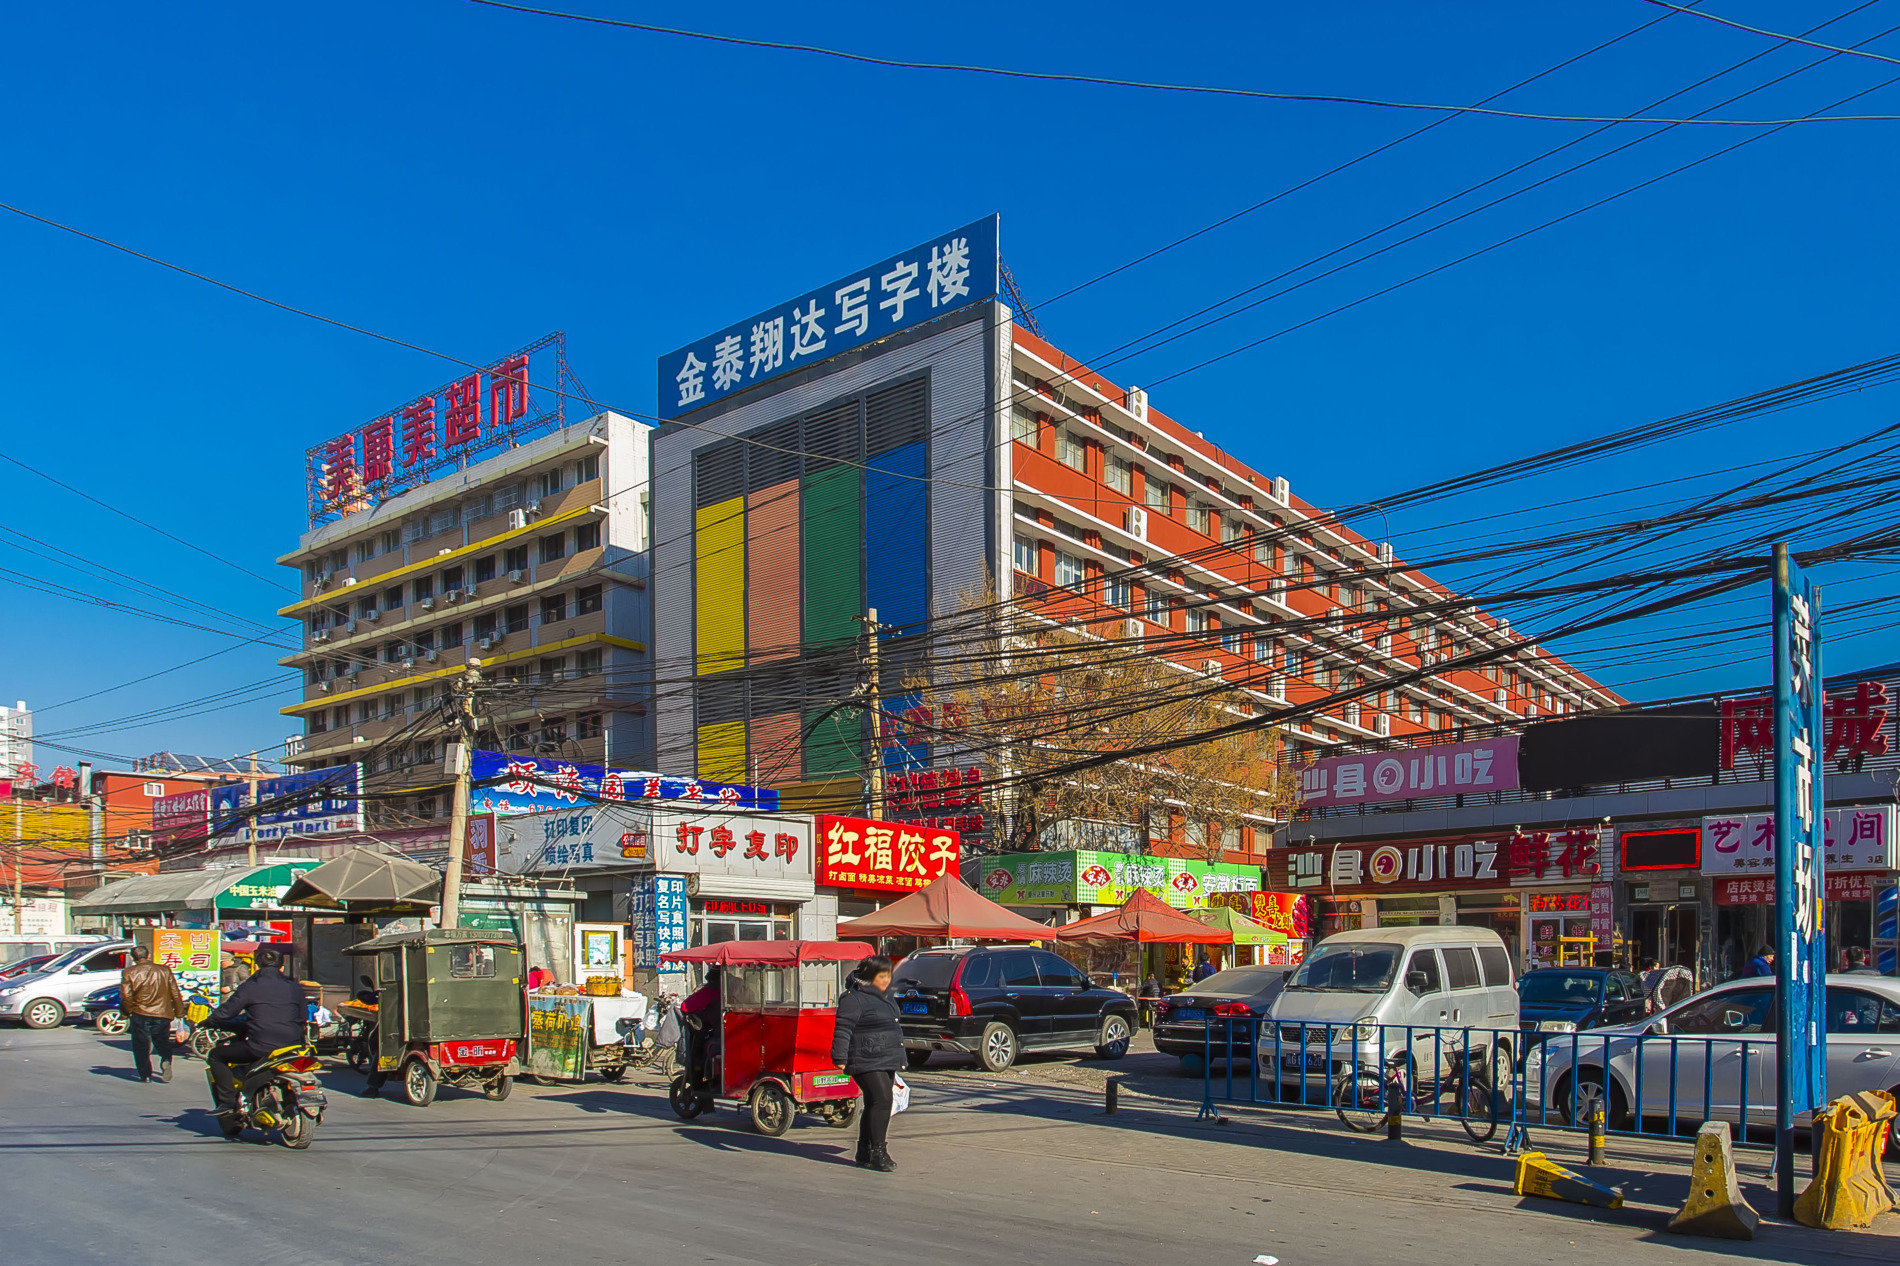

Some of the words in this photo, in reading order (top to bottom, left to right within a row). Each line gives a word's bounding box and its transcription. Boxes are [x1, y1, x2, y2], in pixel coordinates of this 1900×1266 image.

[676, 237, 970, 407] 金泰翔达写字楼
[325, 354, 528, 500] 美廉美超市
[1295, 748, 1494, 801] 沙县小吃
[293, 819, 331, 834] Mart
[544, 816, 593, 839] 打印复印
[545, 843, 594, 865] 喷绘写真
[676, 821, 799, 865] 打字复印
[828, 821, 957, 877] 红福饺子
[1508, 828, 1601, 878] 鲜花
[1288, 841, 1498, 887] 沙县小吃
[1867, 855, 1884, 864] 3店
[828, 871, 856, 882] 打卤面
[1028, 861, 1073, 884] 麻辣烫
[230, 885, 276, 897] 中国玉米油
[657, 879, 683, 894] 复印
[657, 895, 683, 909] 名片
[658, 911, 684, 925] 写真
[160, 932, 212, 950] 초밥
[658, 926, 684, 940] 快照
[161, 952, 211, 969] 寿司
[531, 1010, 581, 1034] 蒸荷叶鸡
